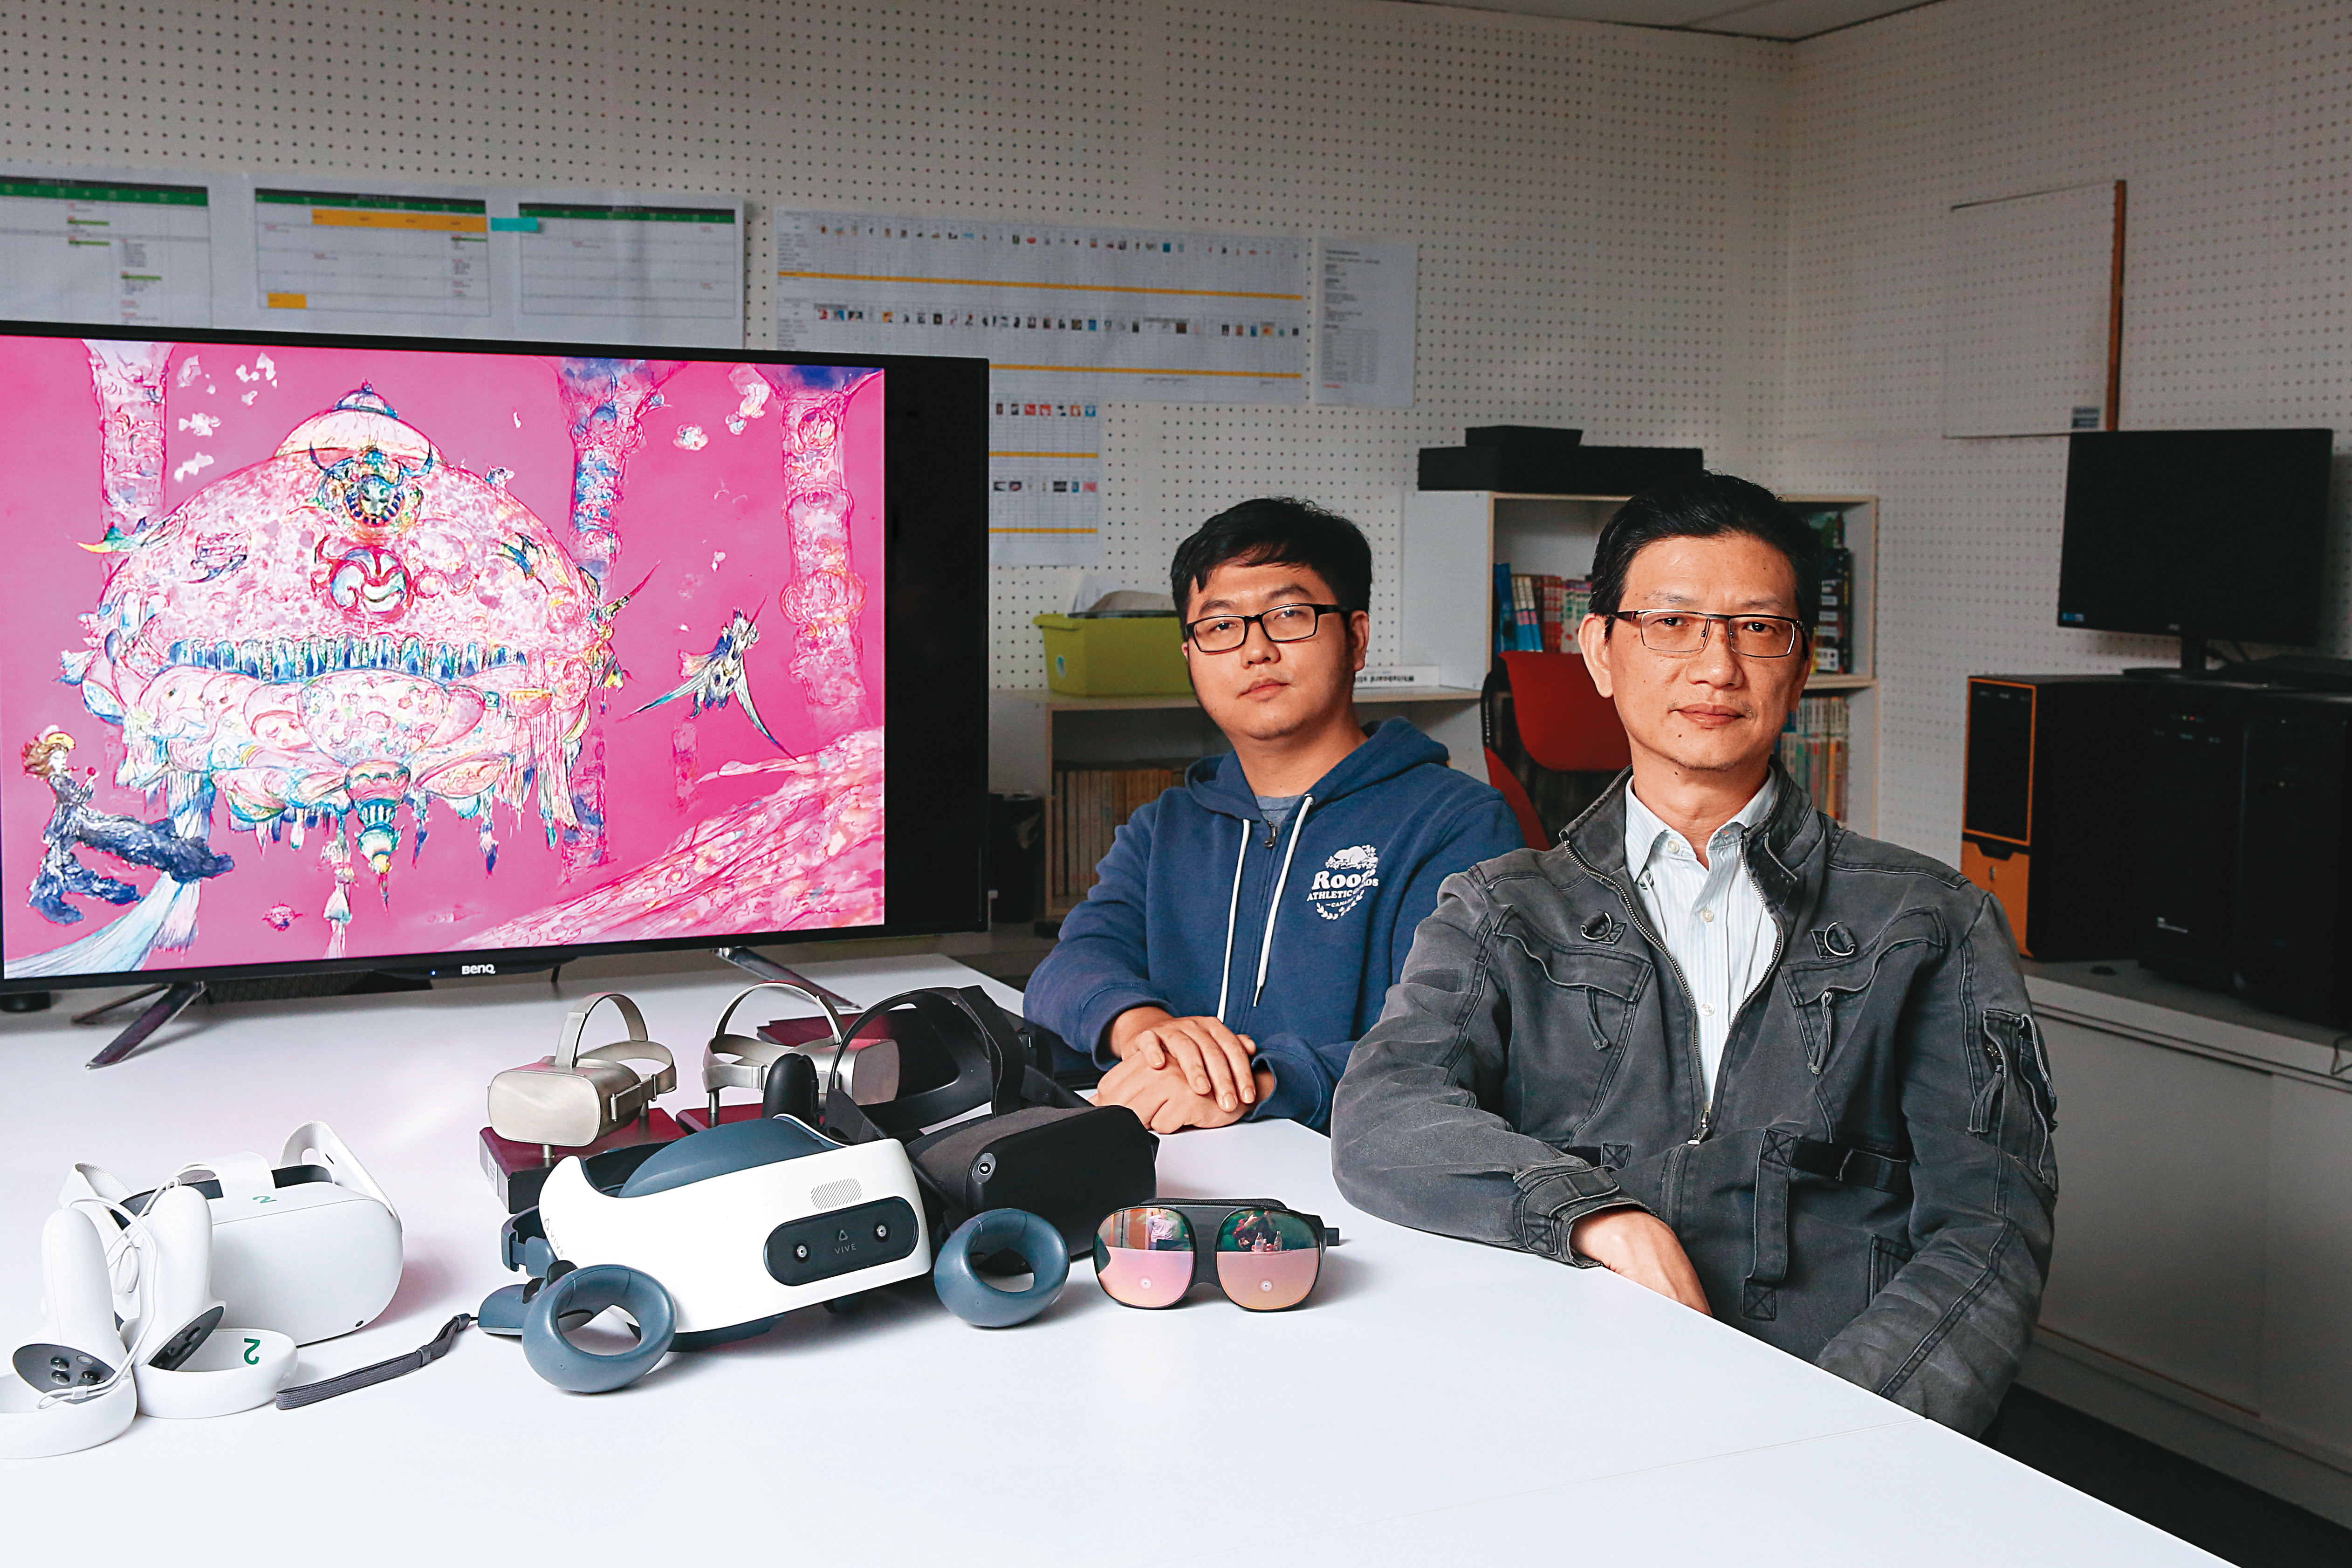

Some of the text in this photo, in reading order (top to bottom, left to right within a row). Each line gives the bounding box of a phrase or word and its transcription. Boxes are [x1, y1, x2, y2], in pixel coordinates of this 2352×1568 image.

[1306, 890, 1353, 902] ATHLETIC
[461, 964, 496, 975] BenQ
[252, 1195, 277, 1204] 2
[551, 1229, 565, 1258] VIVE
[834, 1243, 857, 1254] VIVE
[244, 1338, 261, 1365] 2
